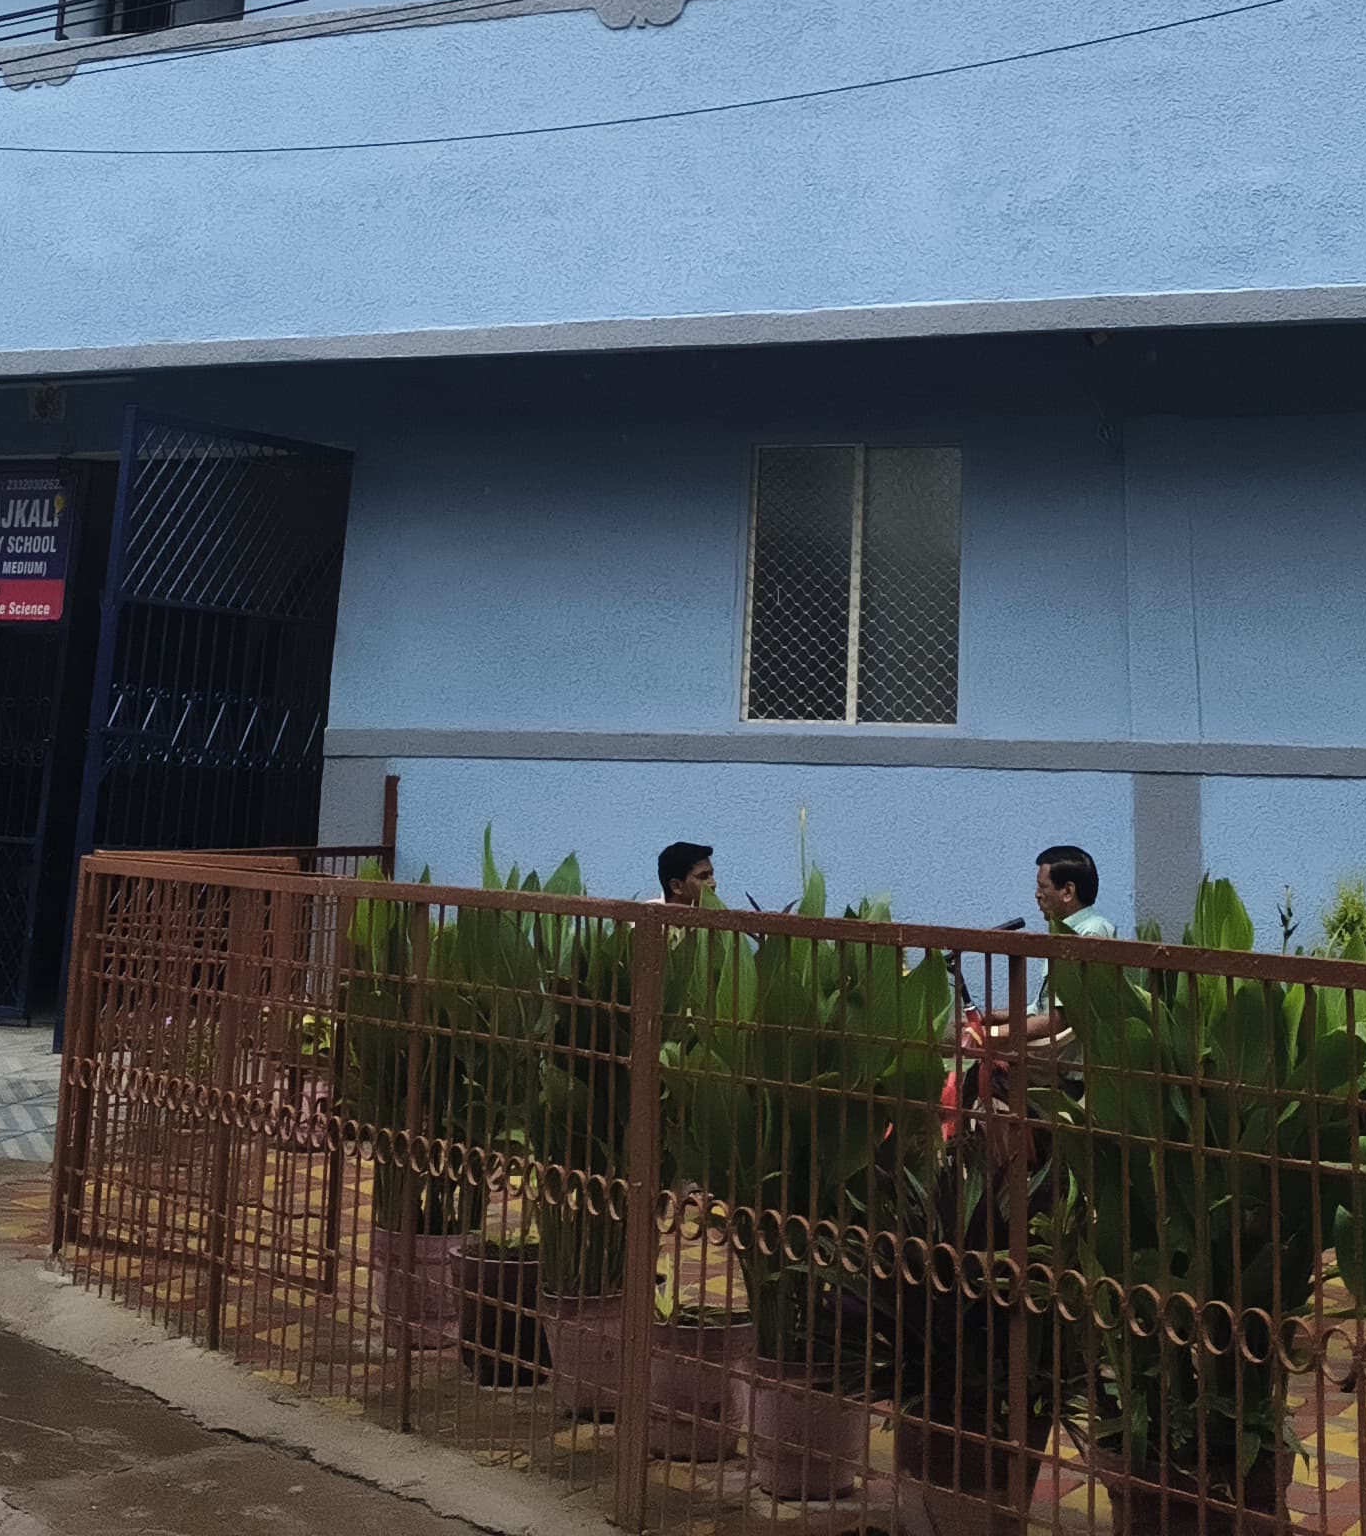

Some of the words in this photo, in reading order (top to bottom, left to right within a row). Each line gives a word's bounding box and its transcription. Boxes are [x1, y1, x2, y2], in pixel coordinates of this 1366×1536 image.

[6, 535, 56, 553] SCHOOL
[2, 561, 47, 576] MEDIUM)
[8, 601, 50, 615] Science
